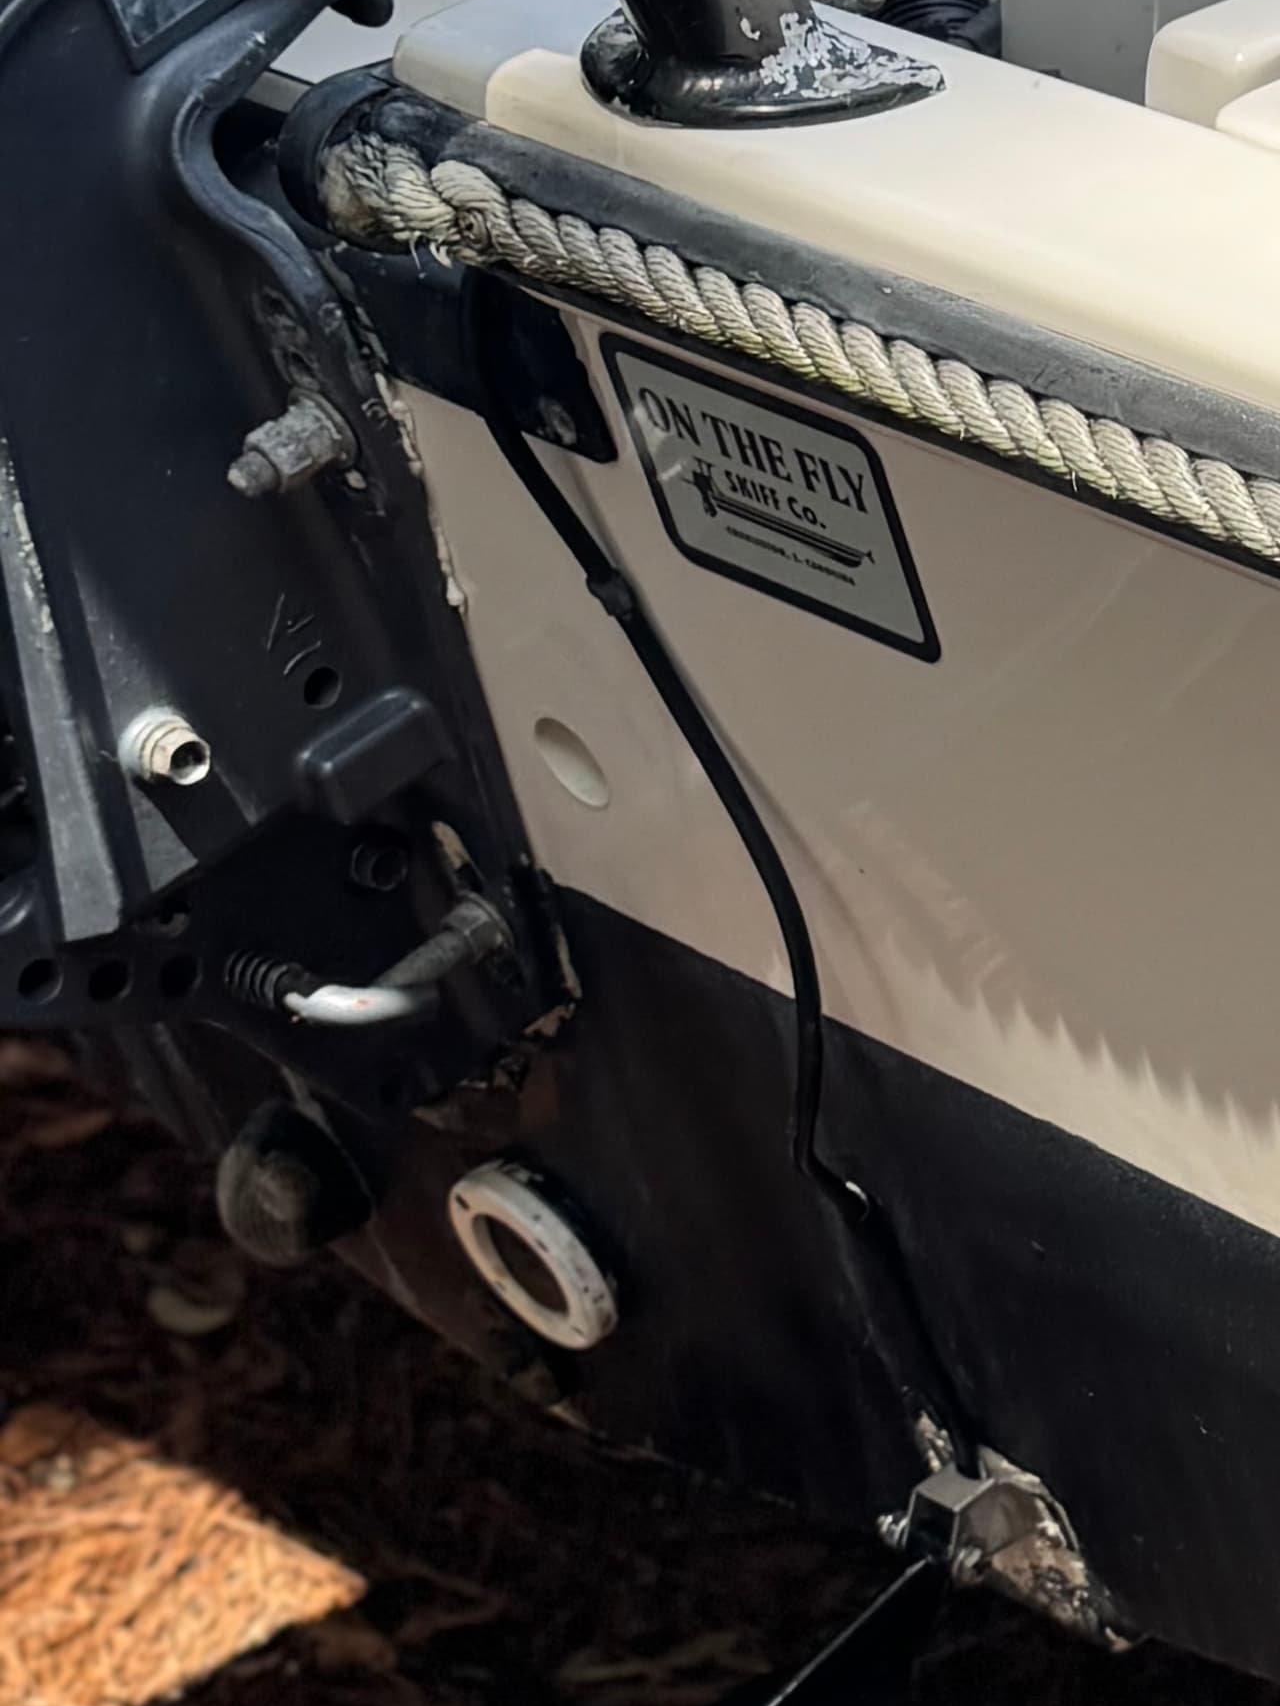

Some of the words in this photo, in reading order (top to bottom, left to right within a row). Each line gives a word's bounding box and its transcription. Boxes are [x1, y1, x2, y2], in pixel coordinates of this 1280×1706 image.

[639, 387, 701, 447] ON
[701, 410, 793, 484] THE
[794, 447, 868, 515] FLY
[724, 469, 780, 511] SKIFF
[787, 496, 827, 529] CO.
